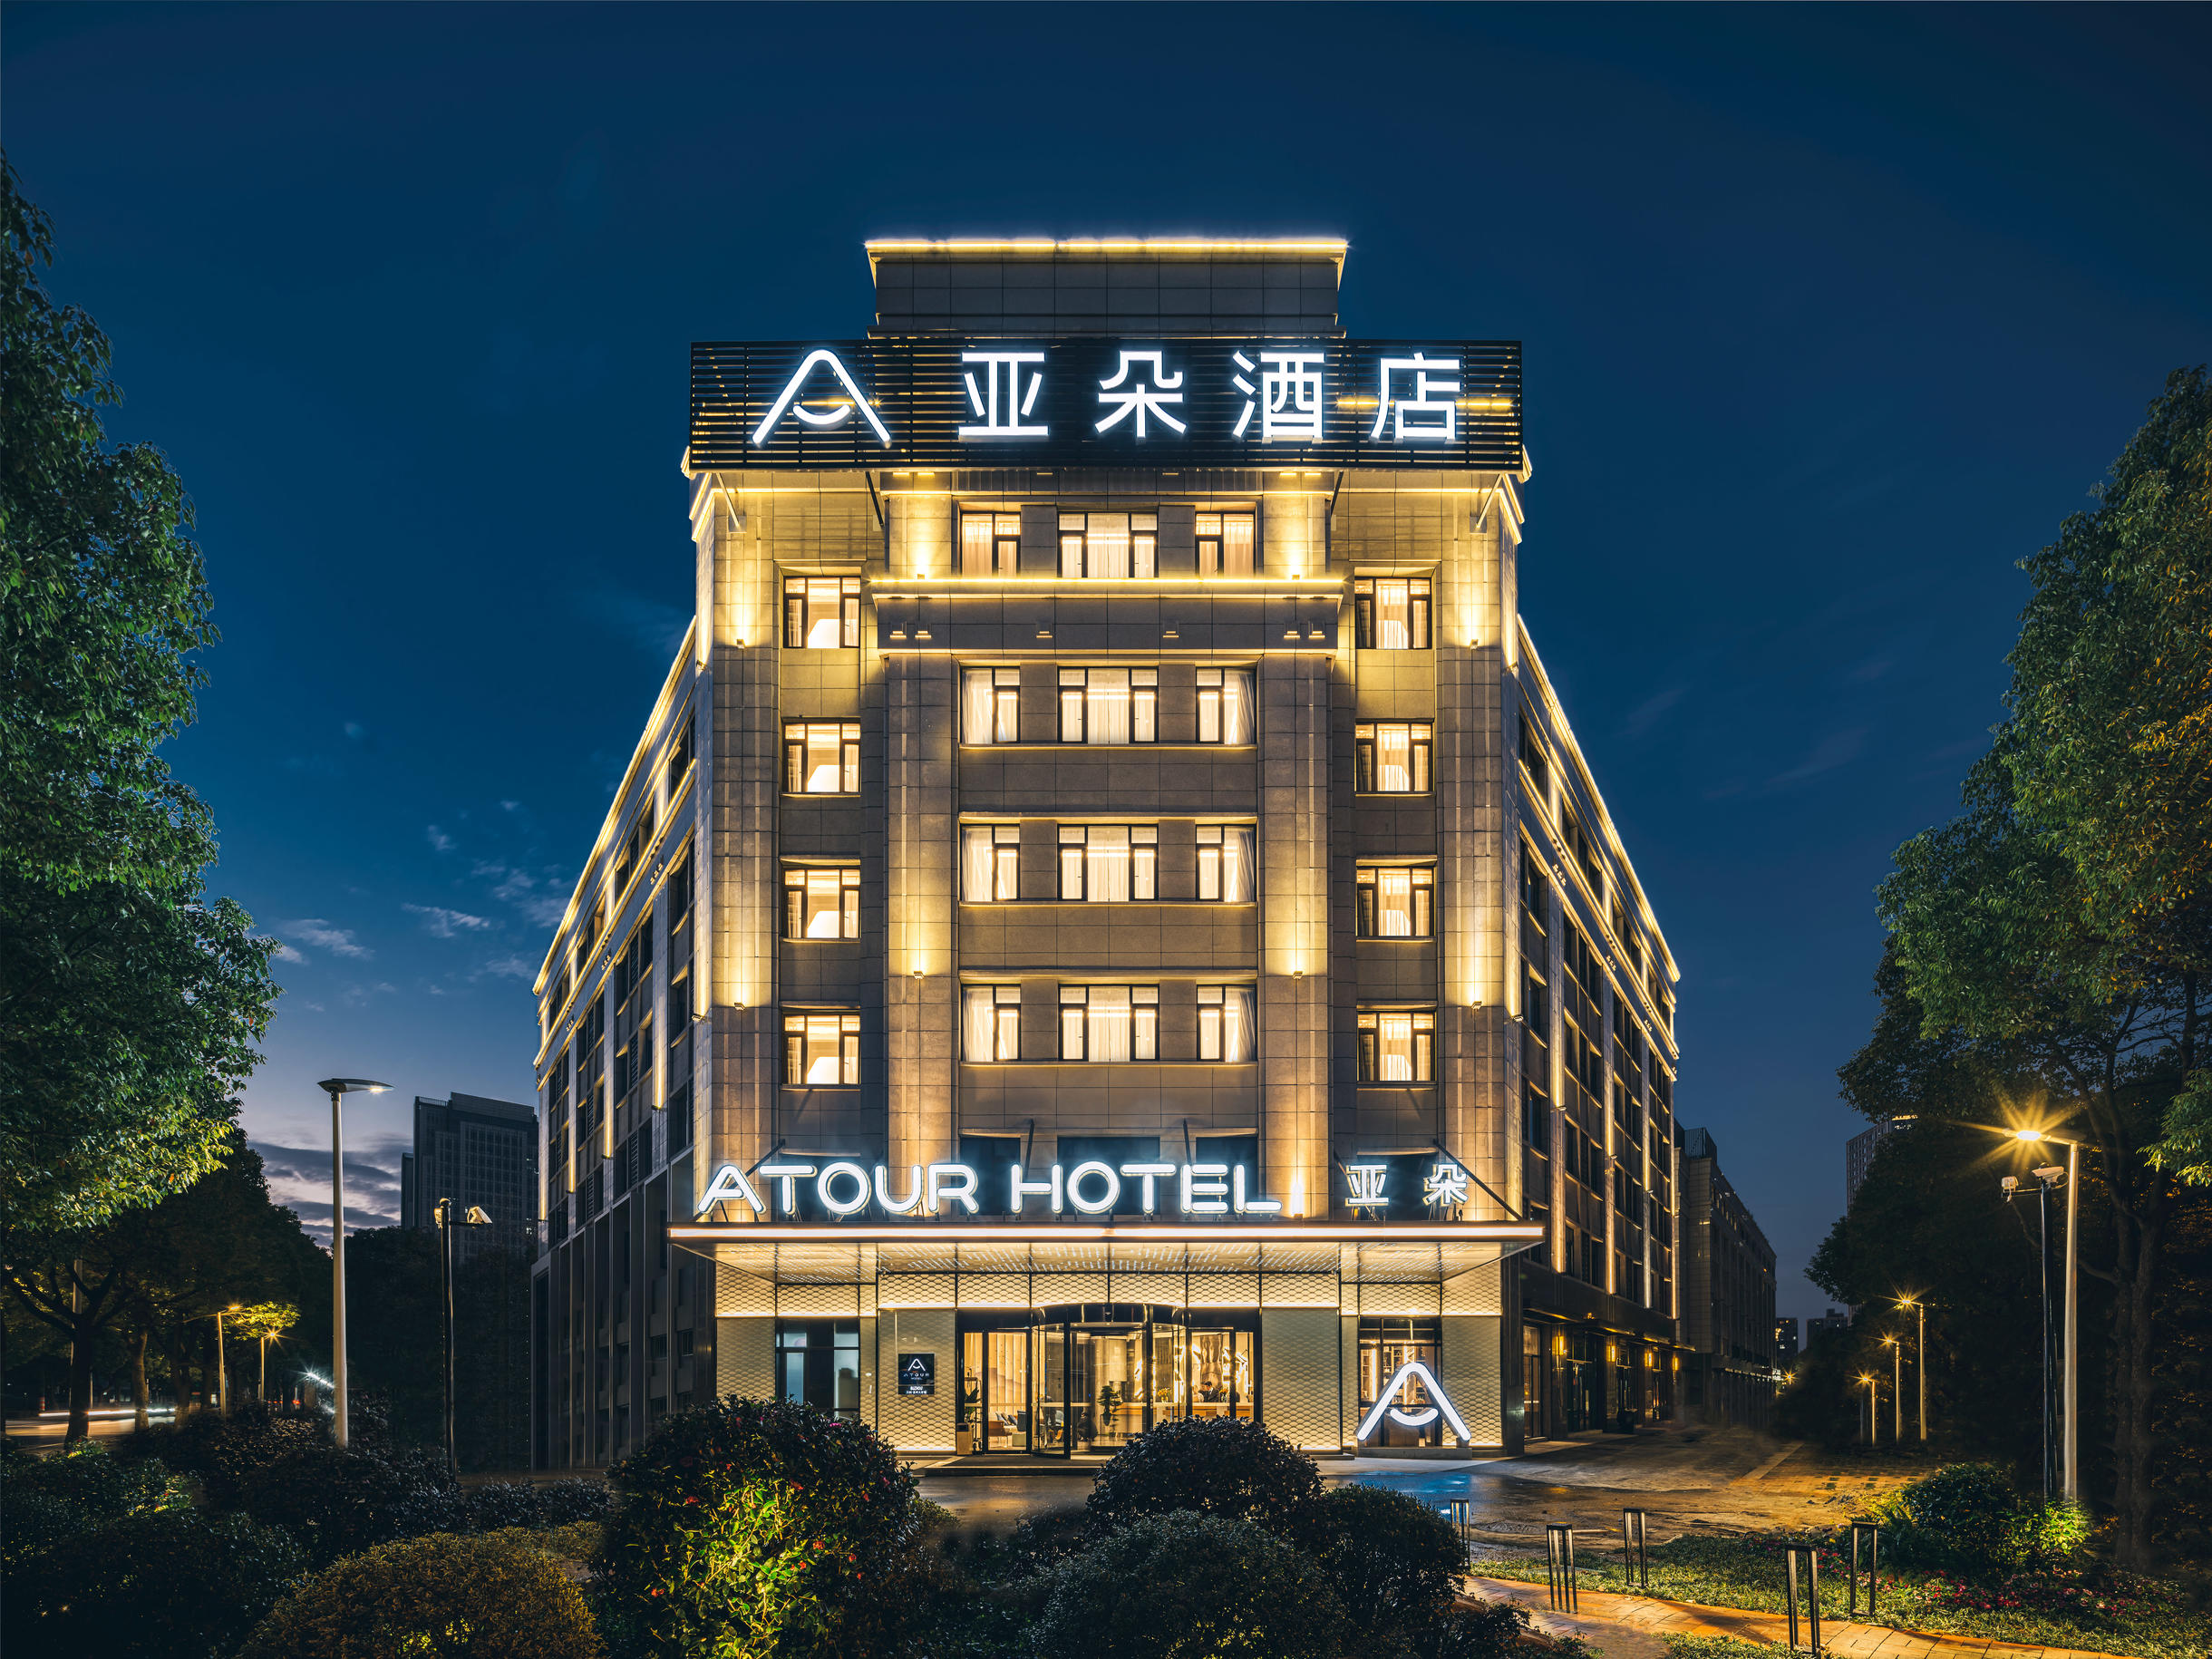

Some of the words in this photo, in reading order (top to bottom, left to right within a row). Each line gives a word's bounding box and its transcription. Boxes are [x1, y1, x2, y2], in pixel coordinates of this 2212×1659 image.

[957, 350, 1462, 443] 亚朵酒店
[694, 1160, 981, 1216] ATOUR
[1009, 1160, 1284, 1215] HOTEL
[1345, 1162, 1471, 1207] 亚朵
